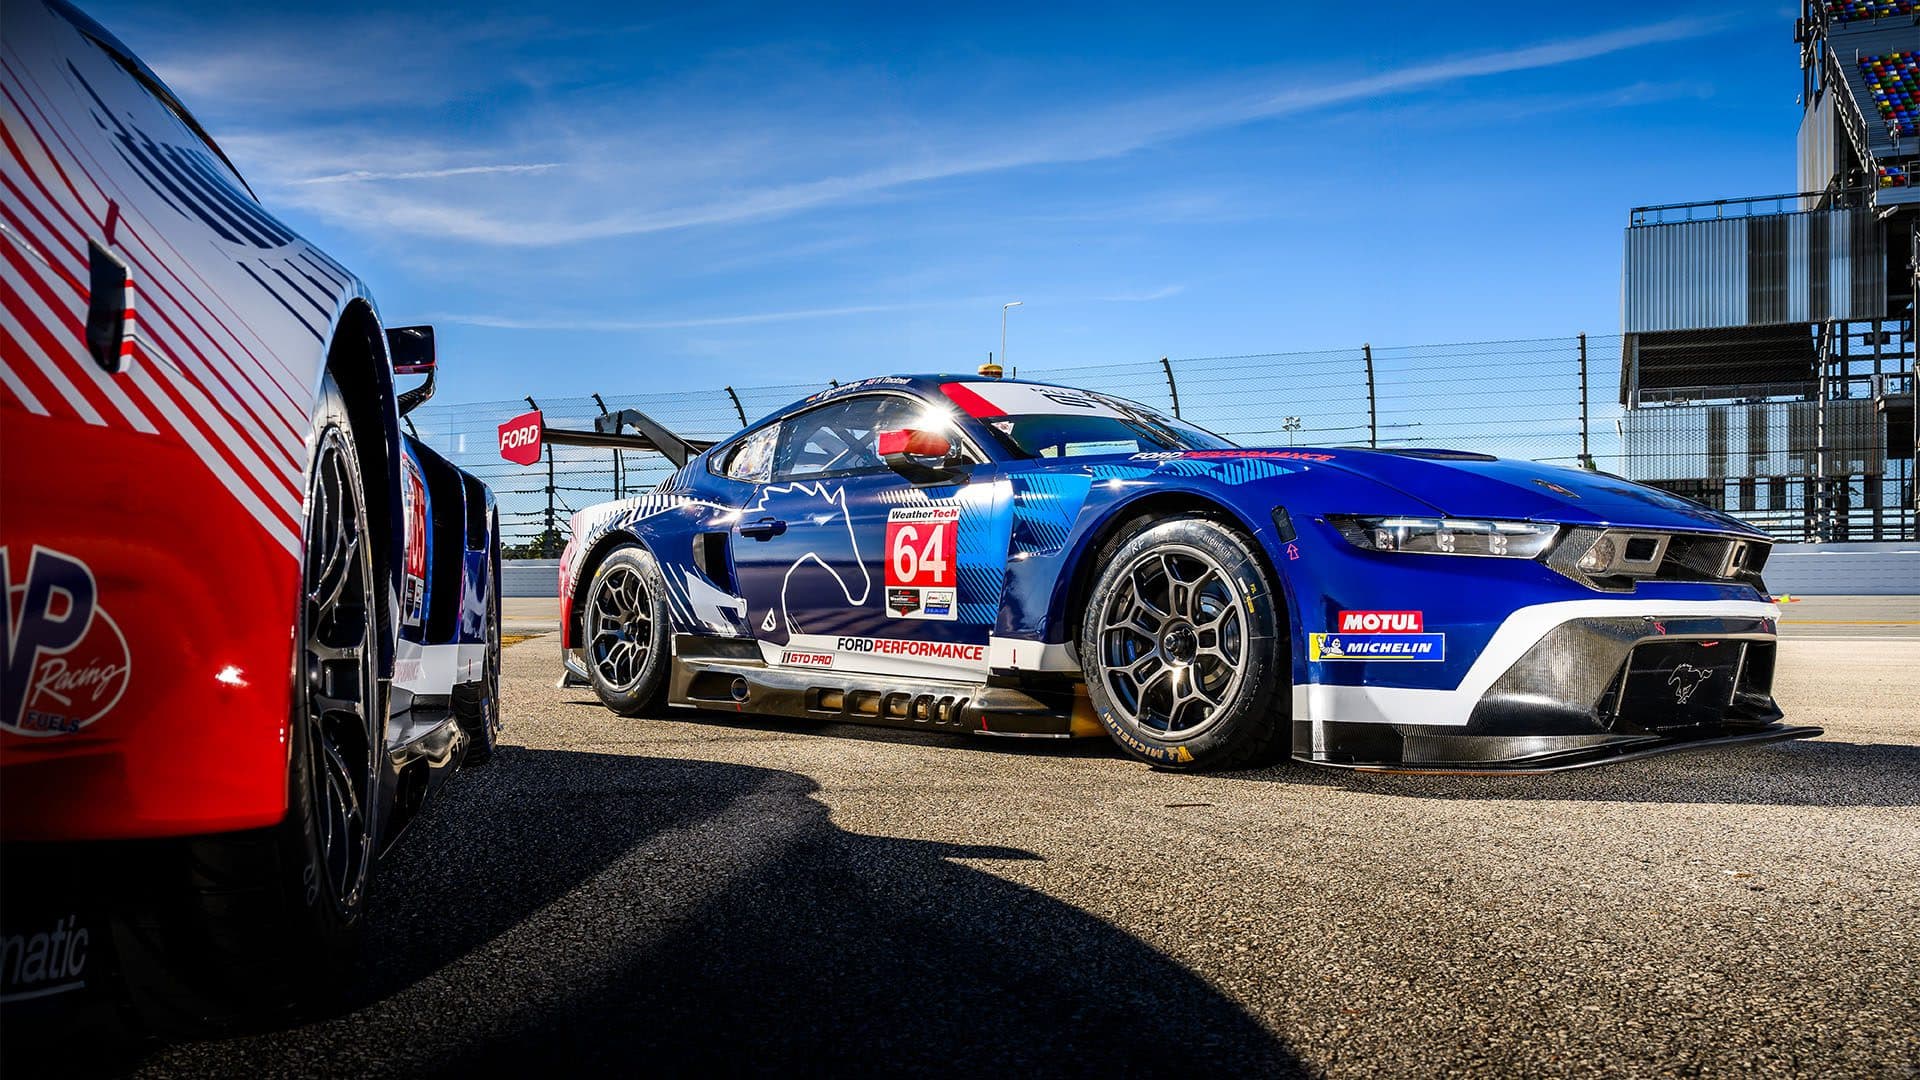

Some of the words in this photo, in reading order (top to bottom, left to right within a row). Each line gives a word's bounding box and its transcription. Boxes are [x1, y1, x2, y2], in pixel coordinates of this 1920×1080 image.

[501, 425, 538, 450] FORD
[892, 509, 957, 519] WeatherTech
[893, 525, 947, 582] 64
[1343, 614, 1418, 630] MOTUL
[1346, 642, 1432, 653] MICHELIN
[790, 654, 810, 663] GTD
[811, 655, 832, 665] PRO
[30, 656, 117, 706] Racing
[27, 711, 81, 734] FUELS
[1104, 712, 1164, 759] MICHELIN
